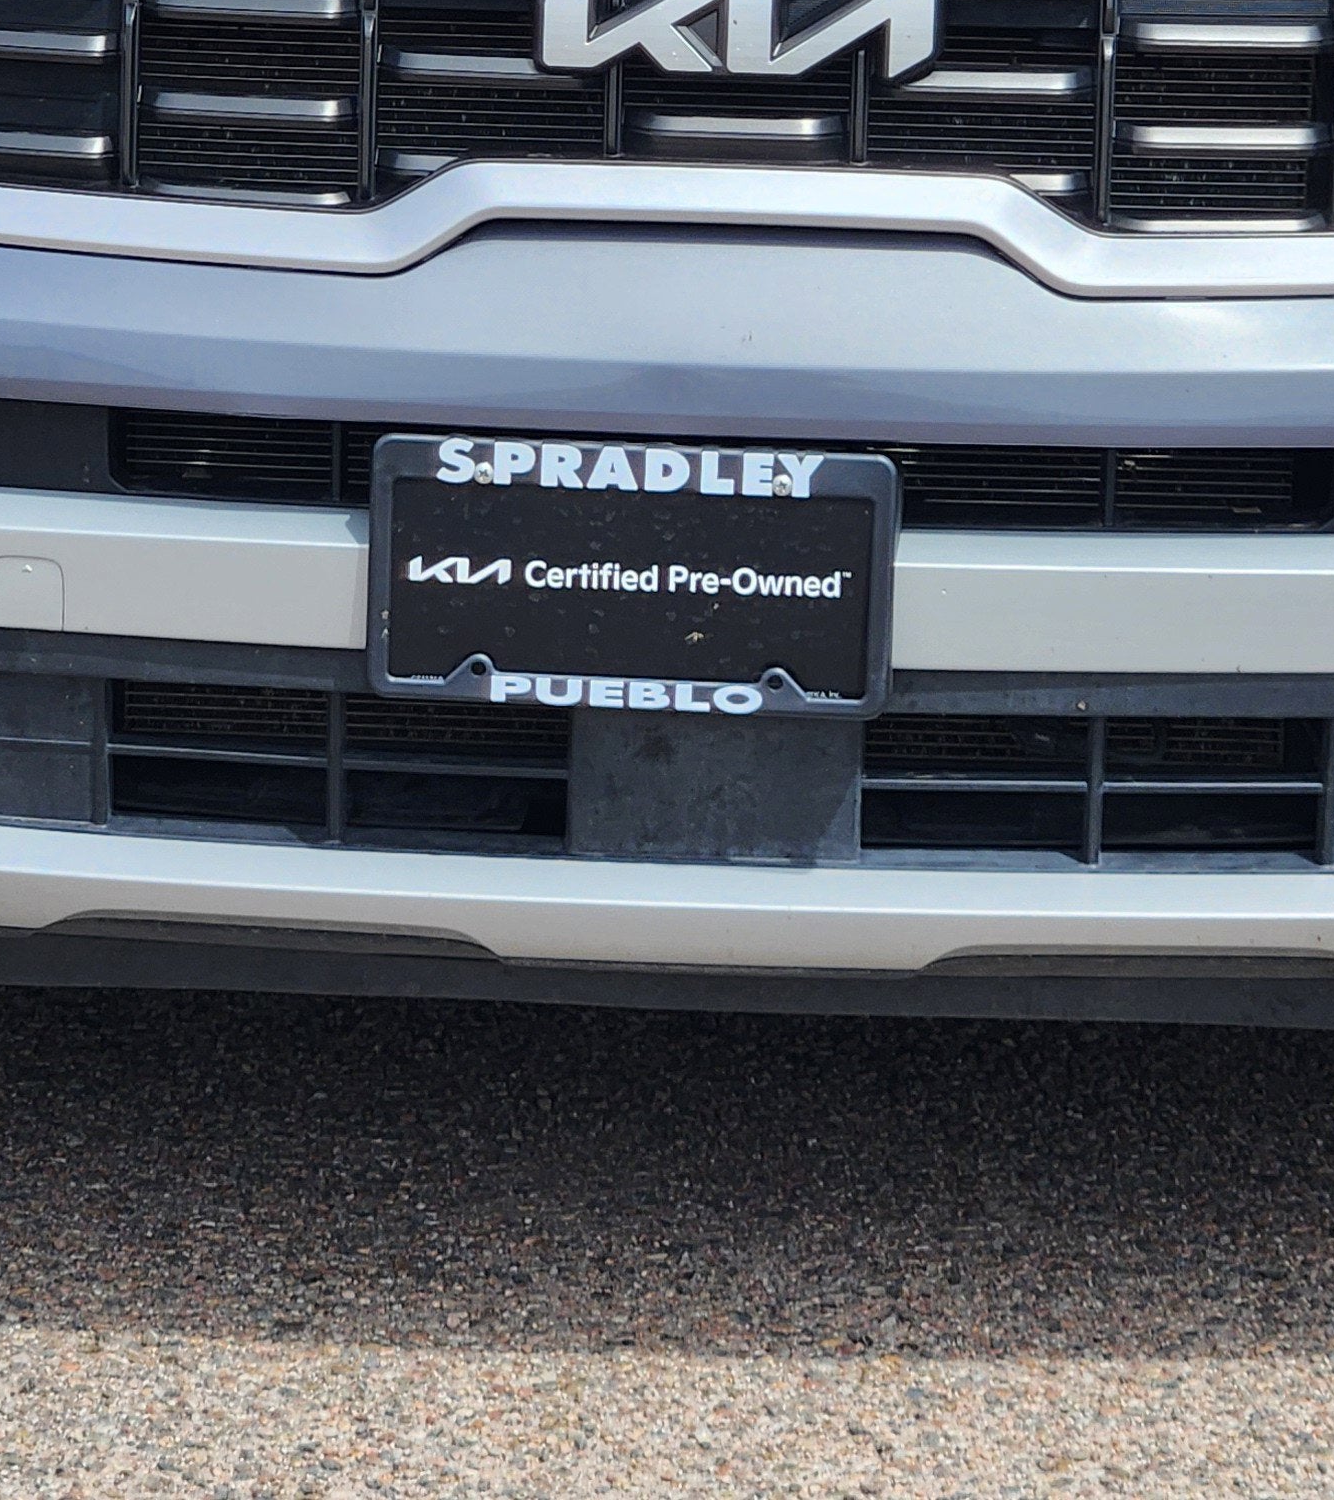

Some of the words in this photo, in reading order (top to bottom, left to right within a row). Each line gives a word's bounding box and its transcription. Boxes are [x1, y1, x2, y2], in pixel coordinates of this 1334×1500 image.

[436, 437, 824, 499] SPRADLEY
[524, 559, 659, 593] Certified
[489, 674, 763, 715] PUEBLO
